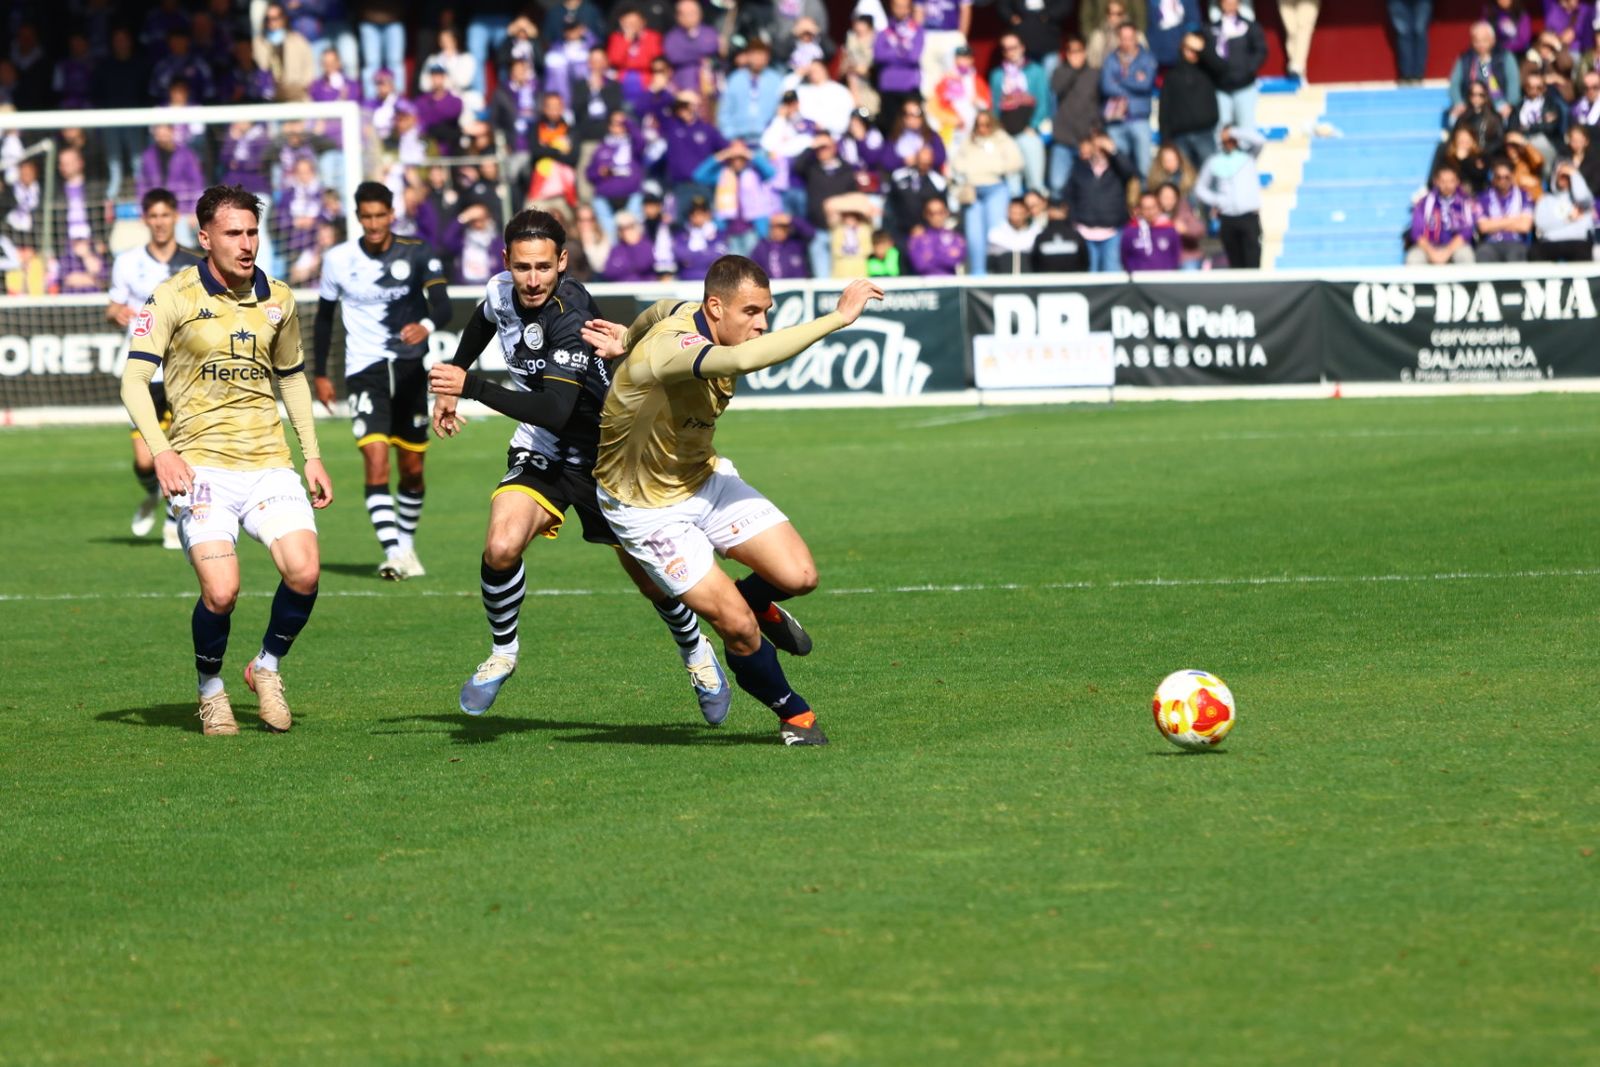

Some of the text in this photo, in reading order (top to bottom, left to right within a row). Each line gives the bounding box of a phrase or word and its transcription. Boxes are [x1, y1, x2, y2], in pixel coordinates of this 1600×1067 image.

[1353, 279, 1597, 324] OS-DA-MA
[1111, 304, 1256, 338] De la Peña
[1113, 341, 1267, 368] ASESORÍA
[1417, 346, 1538, 369] SALAMANCA
[642, 528, 677, 564] 15
